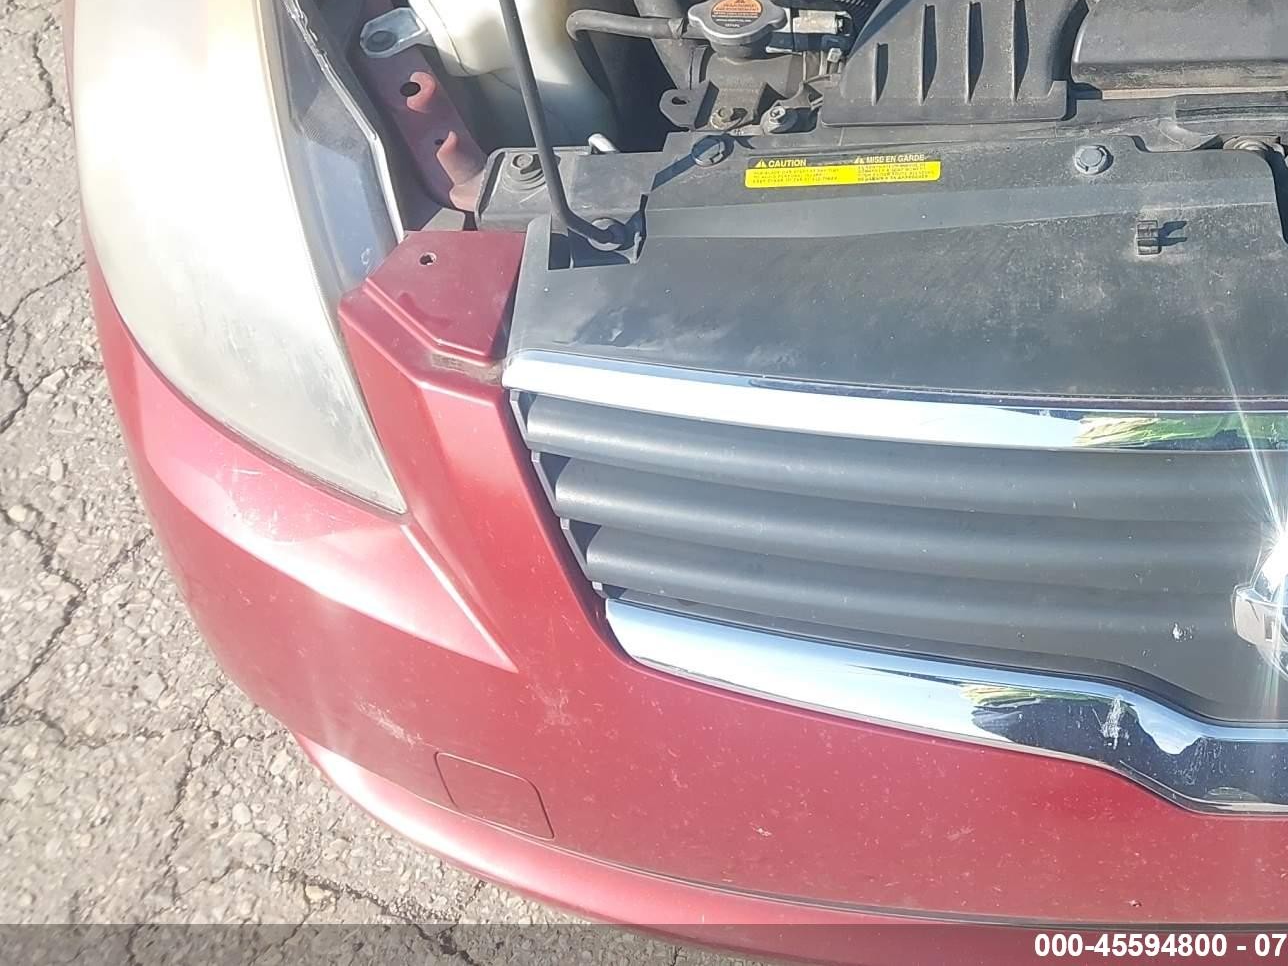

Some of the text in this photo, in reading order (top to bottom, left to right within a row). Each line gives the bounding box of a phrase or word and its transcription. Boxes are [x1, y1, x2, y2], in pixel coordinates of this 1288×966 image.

[768, 158, 807, 168] CAUTION
[885, 154, 897, 163] EN
[897, 153, 925, 163] GARDE
